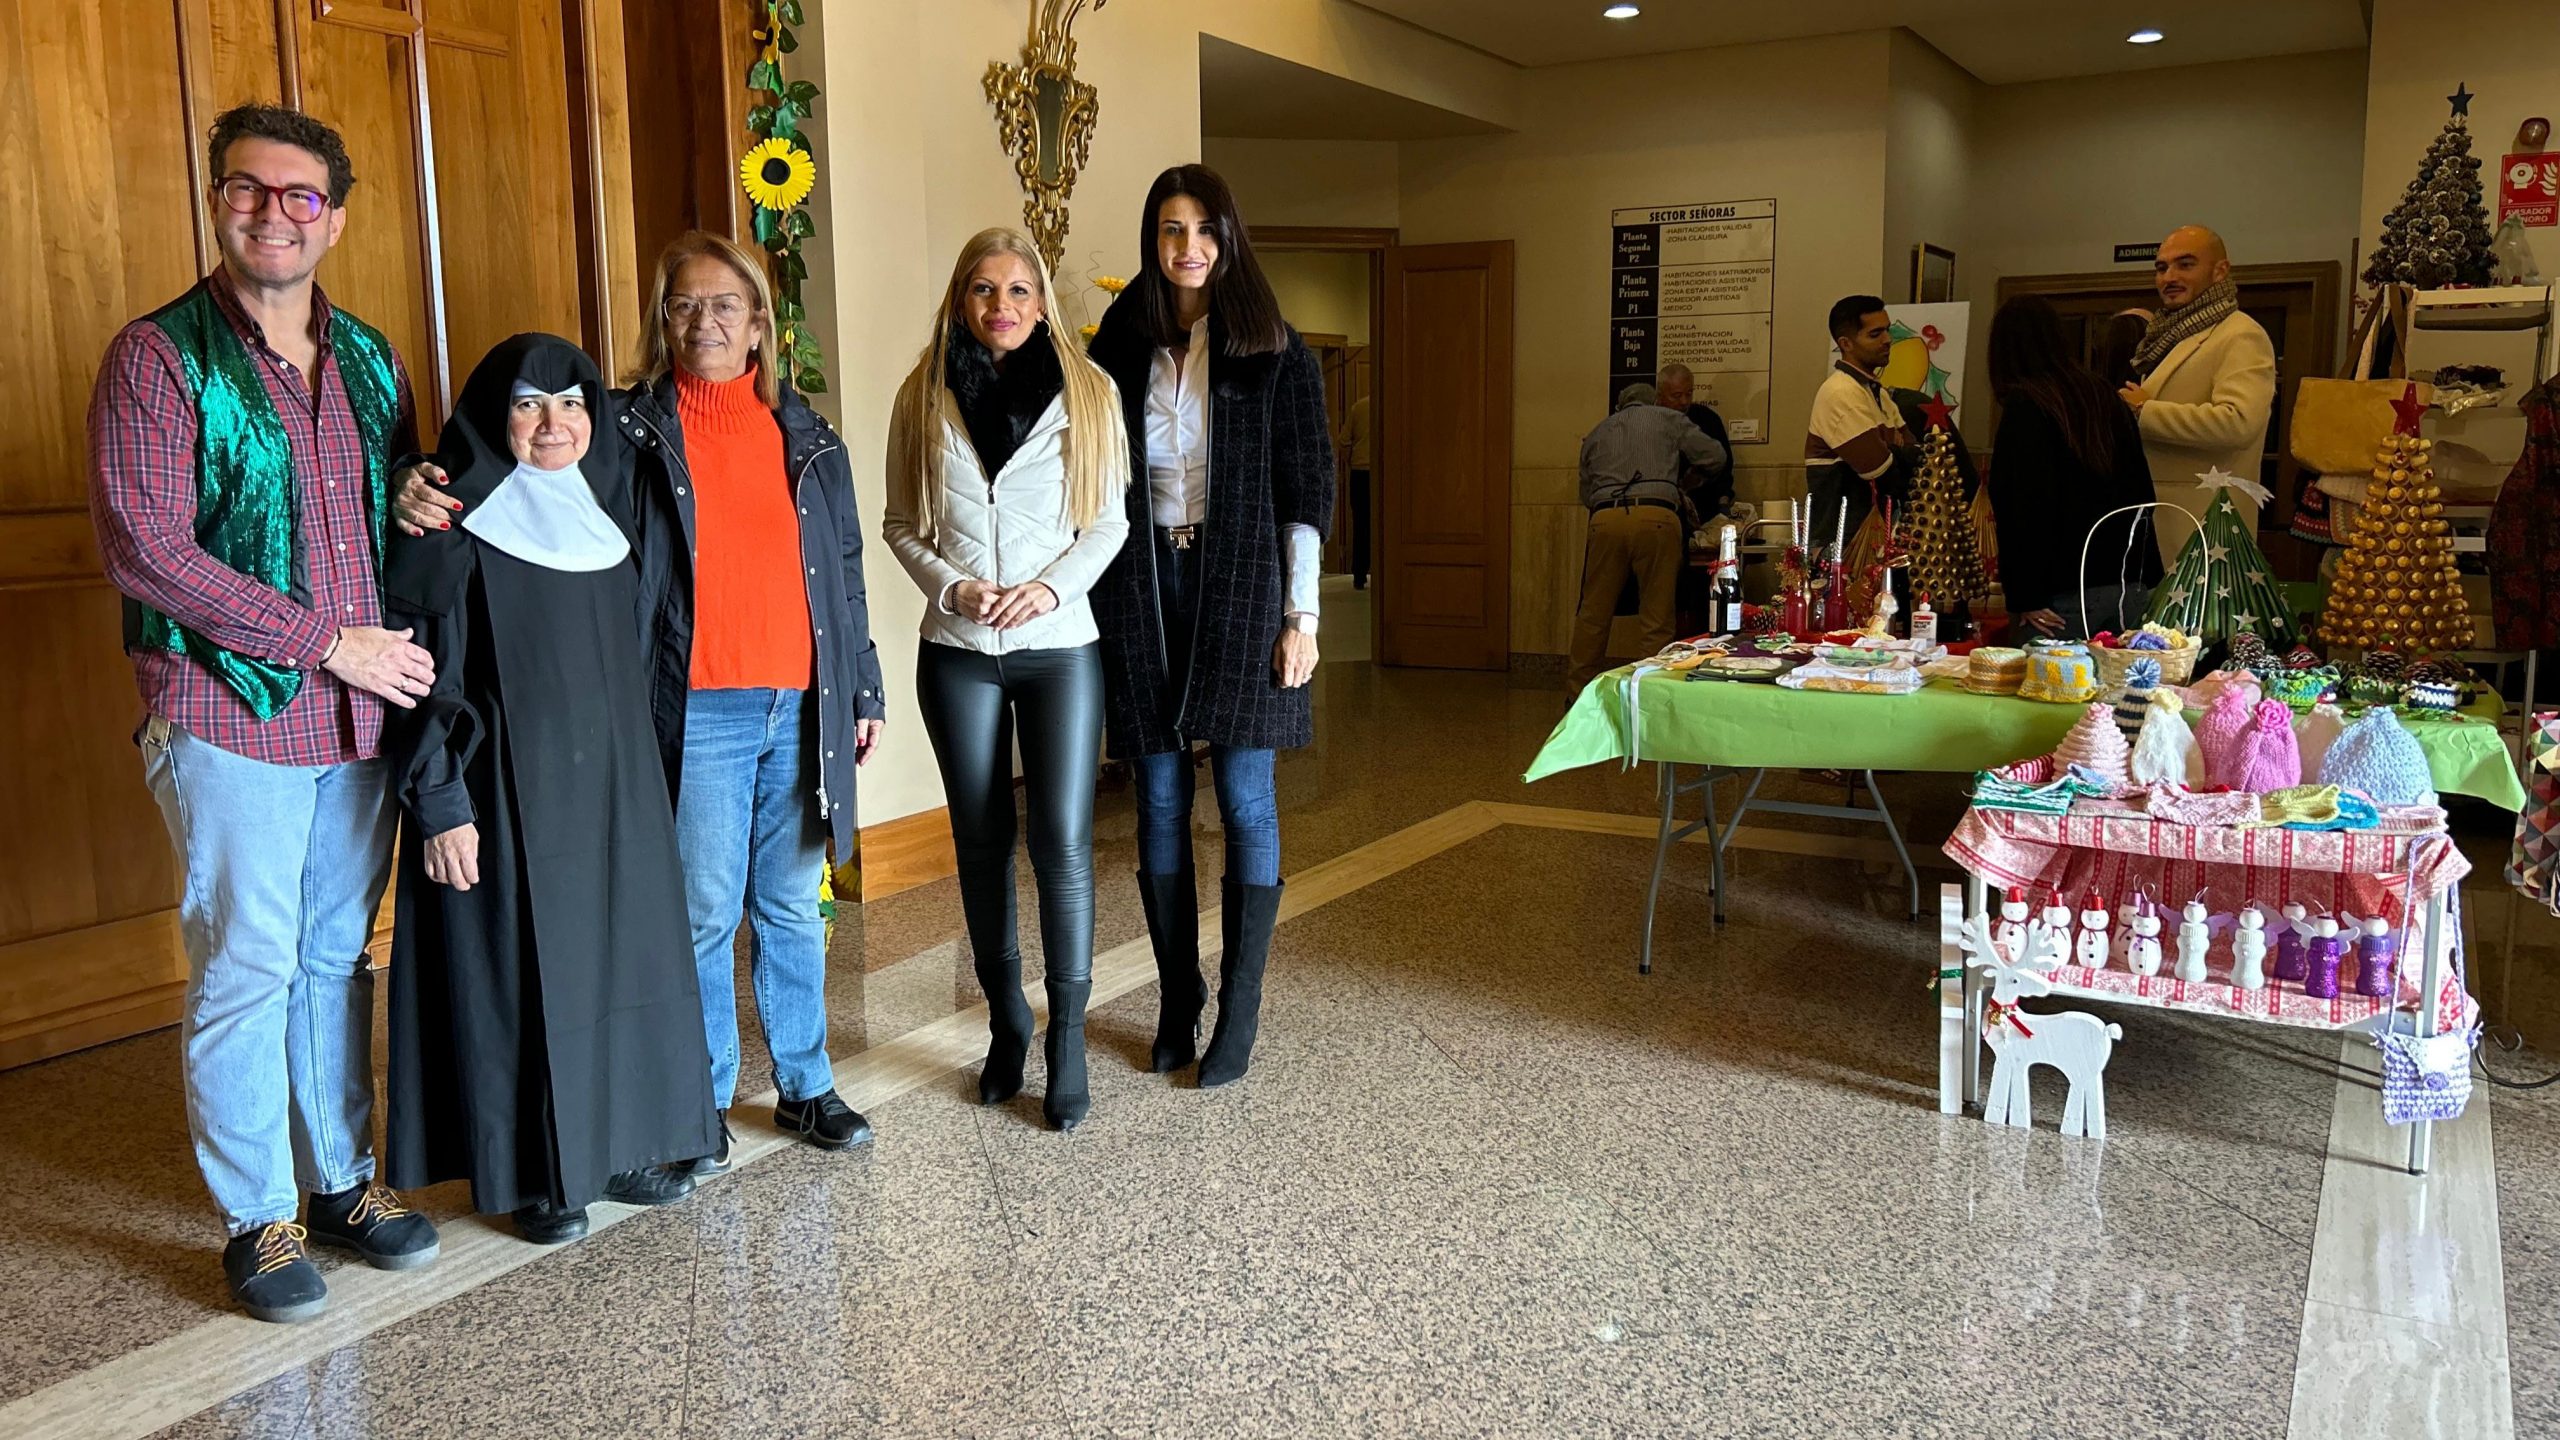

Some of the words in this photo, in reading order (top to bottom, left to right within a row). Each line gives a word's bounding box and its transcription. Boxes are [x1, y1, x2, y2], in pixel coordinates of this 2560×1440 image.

[1649, 209, 1686, 222] SECTOR
[1689, 206, 1736, 219] SEÑORAS
[2505, 207, 2552, 216] AVISADOR
[2522, 215, 2549, 223] NORO
[1722, 223, 1752, 231] VALIDAS
[1622, 232, 1648, 241] Planta
[1688, 233, 1728, 242] CLAUSURA
[1618, 242, 1651, 253] Segunda
[2118, 247, 2158, 257] ADMINIS
[1629, 254, 1640, 263] P2
[1719, 267, 1771, 276] MATRIMONIOS
[1622, 274, 1647, 285] Planta
[1719, 276, 1757, 284] ASISTIDAS
[1618, 287, 1649, 298] Primera
[1710, 285, 1749, 293] ASISTIDAS
[1702, 294, 1741, 302] ASISTIDAS
[1628, 303, 1638, 314] P1
[1620, 327, 1645, 337] Planta
[1623, 339, 1641, 352] Baja
[1715, 338, 1750, 346] VALIDAS
[1717, 346, 1752, 354] VALIDAS
[1626, 357, 1638, 367] PB
[1686, 356, 1724, 364] COCINAS
